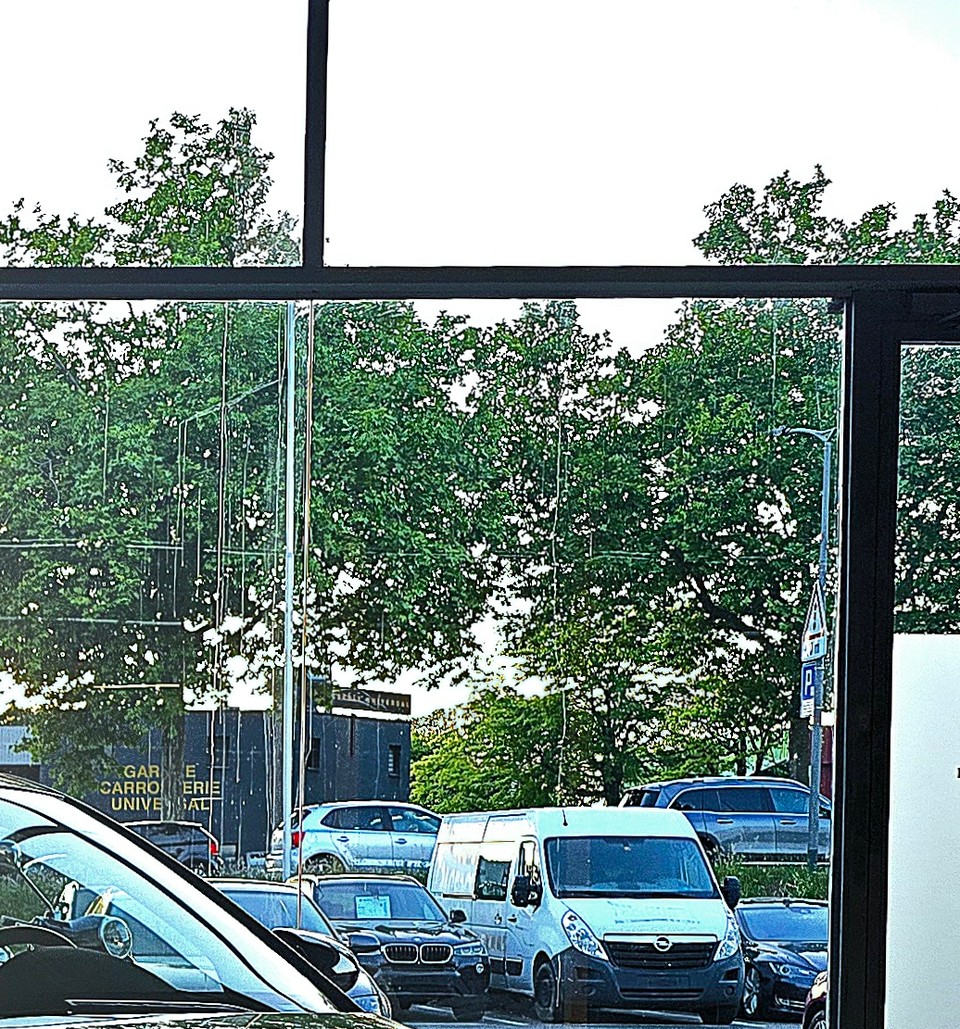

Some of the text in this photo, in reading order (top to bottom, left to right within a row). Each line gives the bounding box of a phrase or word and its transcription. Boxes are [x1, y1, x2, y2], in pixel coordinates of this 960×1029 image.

[123, 764, 196, 778] GARE
[100, 780, 220, 795] CARROERIE
[111, 797, 210, 811] UNIVESAL
